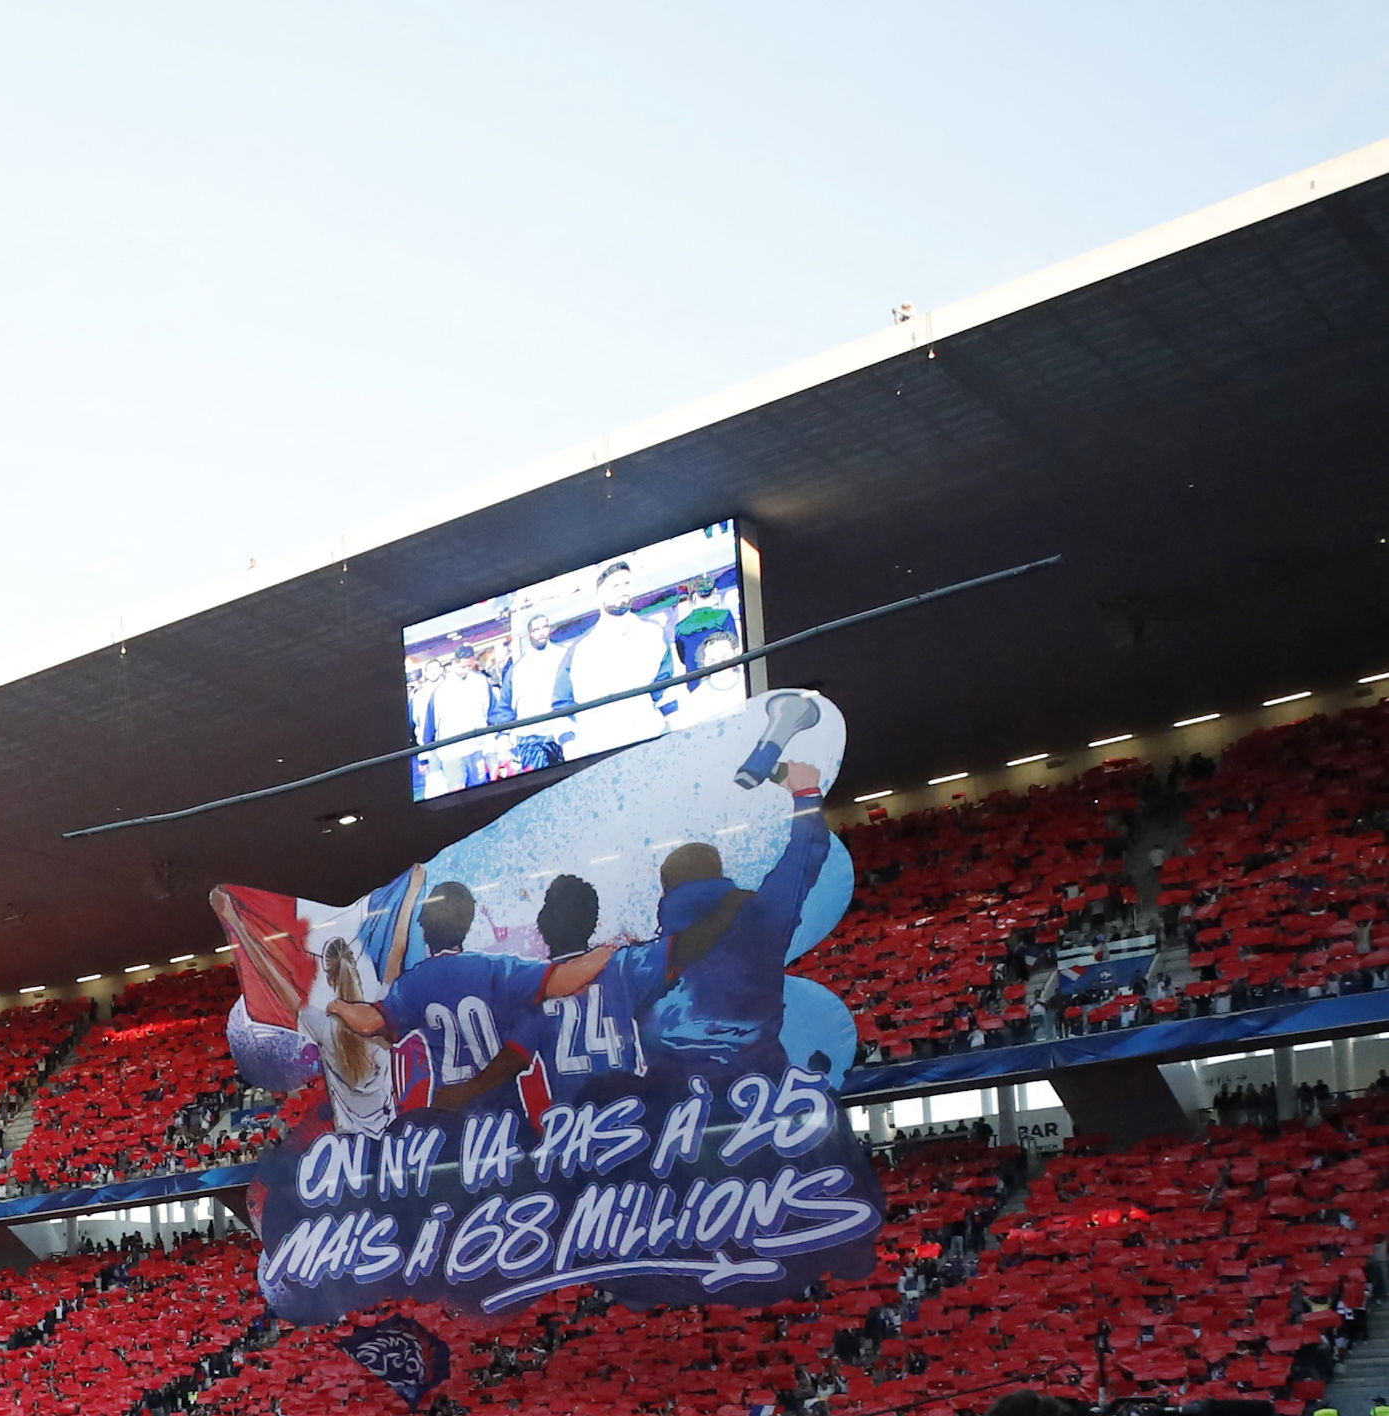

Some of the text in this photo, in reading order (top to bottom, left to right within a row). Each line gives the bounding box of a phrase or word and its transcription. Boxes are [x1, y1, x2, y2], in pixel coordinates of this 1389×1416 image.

[425, 984, 625, 1085] 20 24
[298, 1066, 831, 1204] ON N'Y VA PAS À 25
[445, 1194, 555, 1279] 68
